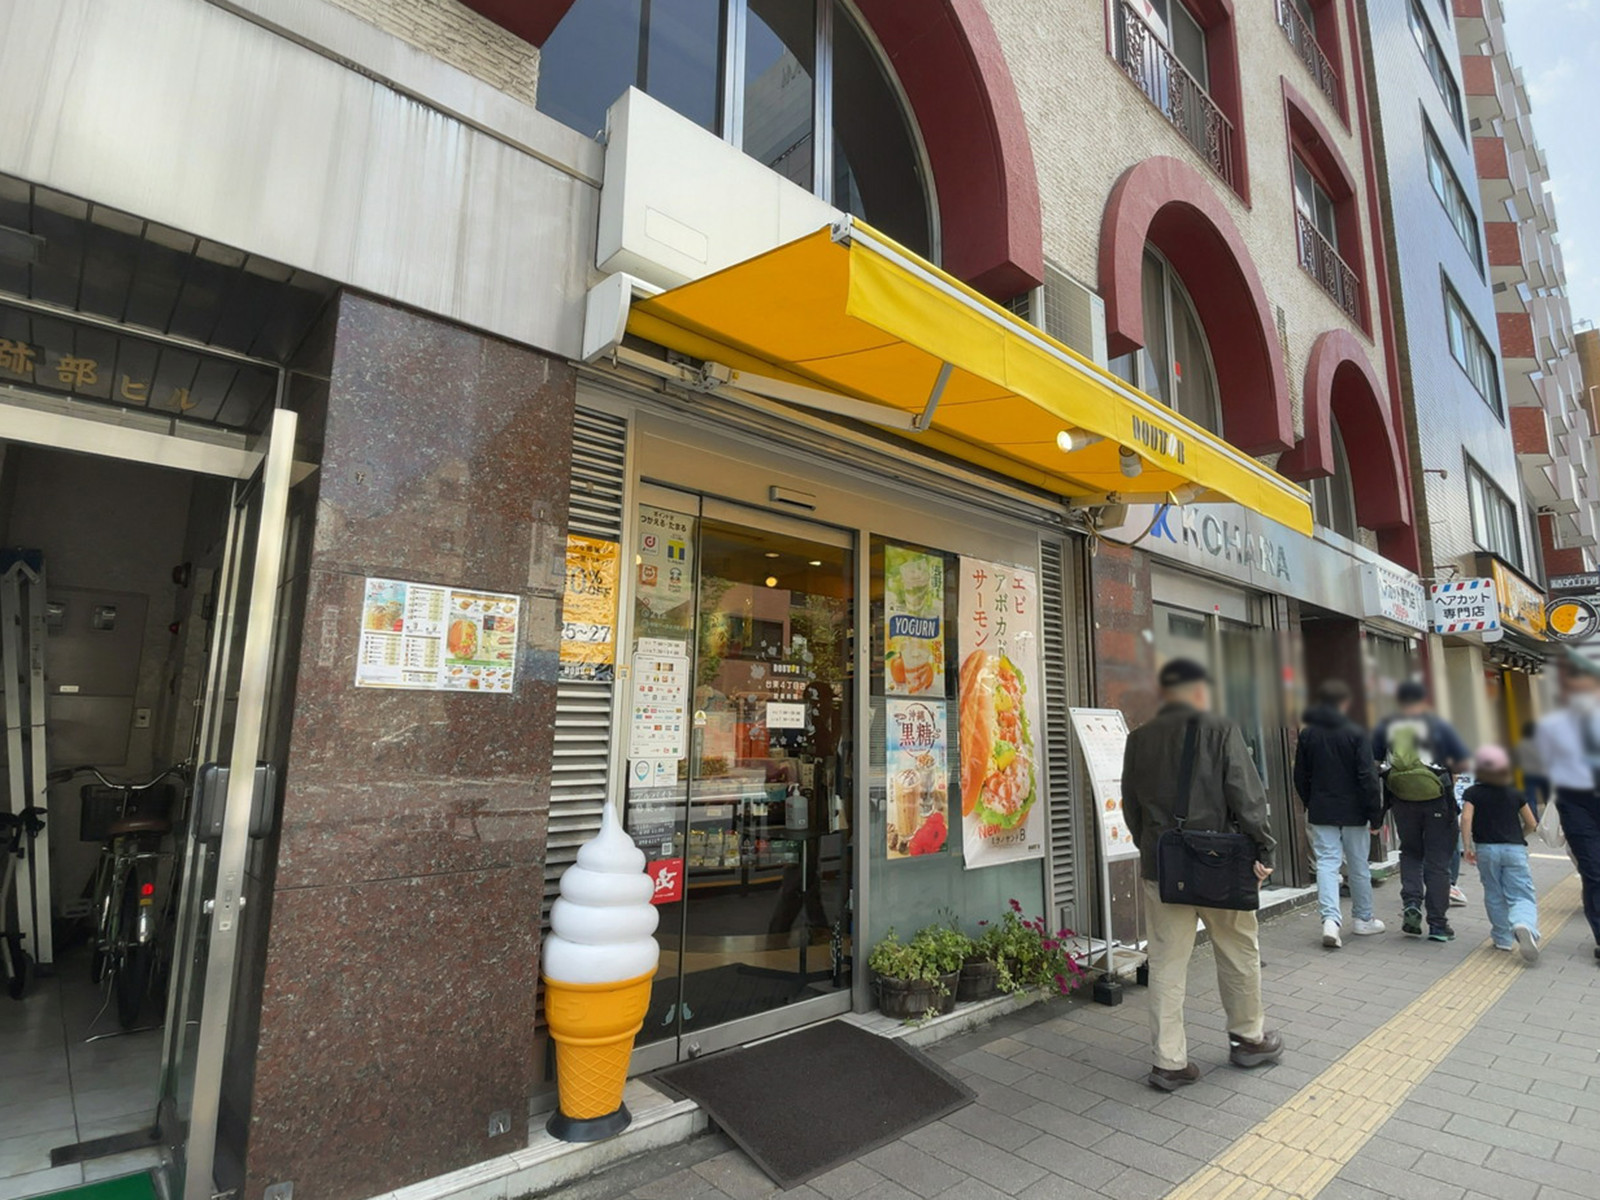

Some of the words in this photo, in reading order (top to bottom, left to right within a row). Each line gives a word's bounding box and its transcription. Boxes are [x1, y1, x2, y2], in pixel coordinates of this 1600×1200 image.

[1131, 415, 1186, 465] DOUTOR
[1182, 505, 1291, 582] KOHARA
[972, 568, 990, 648] サーモン
[1012, 577, 1027, 615] エビ
[1435, 592, 1490, 606] ヘアカット
[1442, 605, 1485, 619] 専門店
[895, 616, 937, 638] YOGURN
[899, 722, 933, 748] 黒糖
[978, 824, 1001, 840] New
